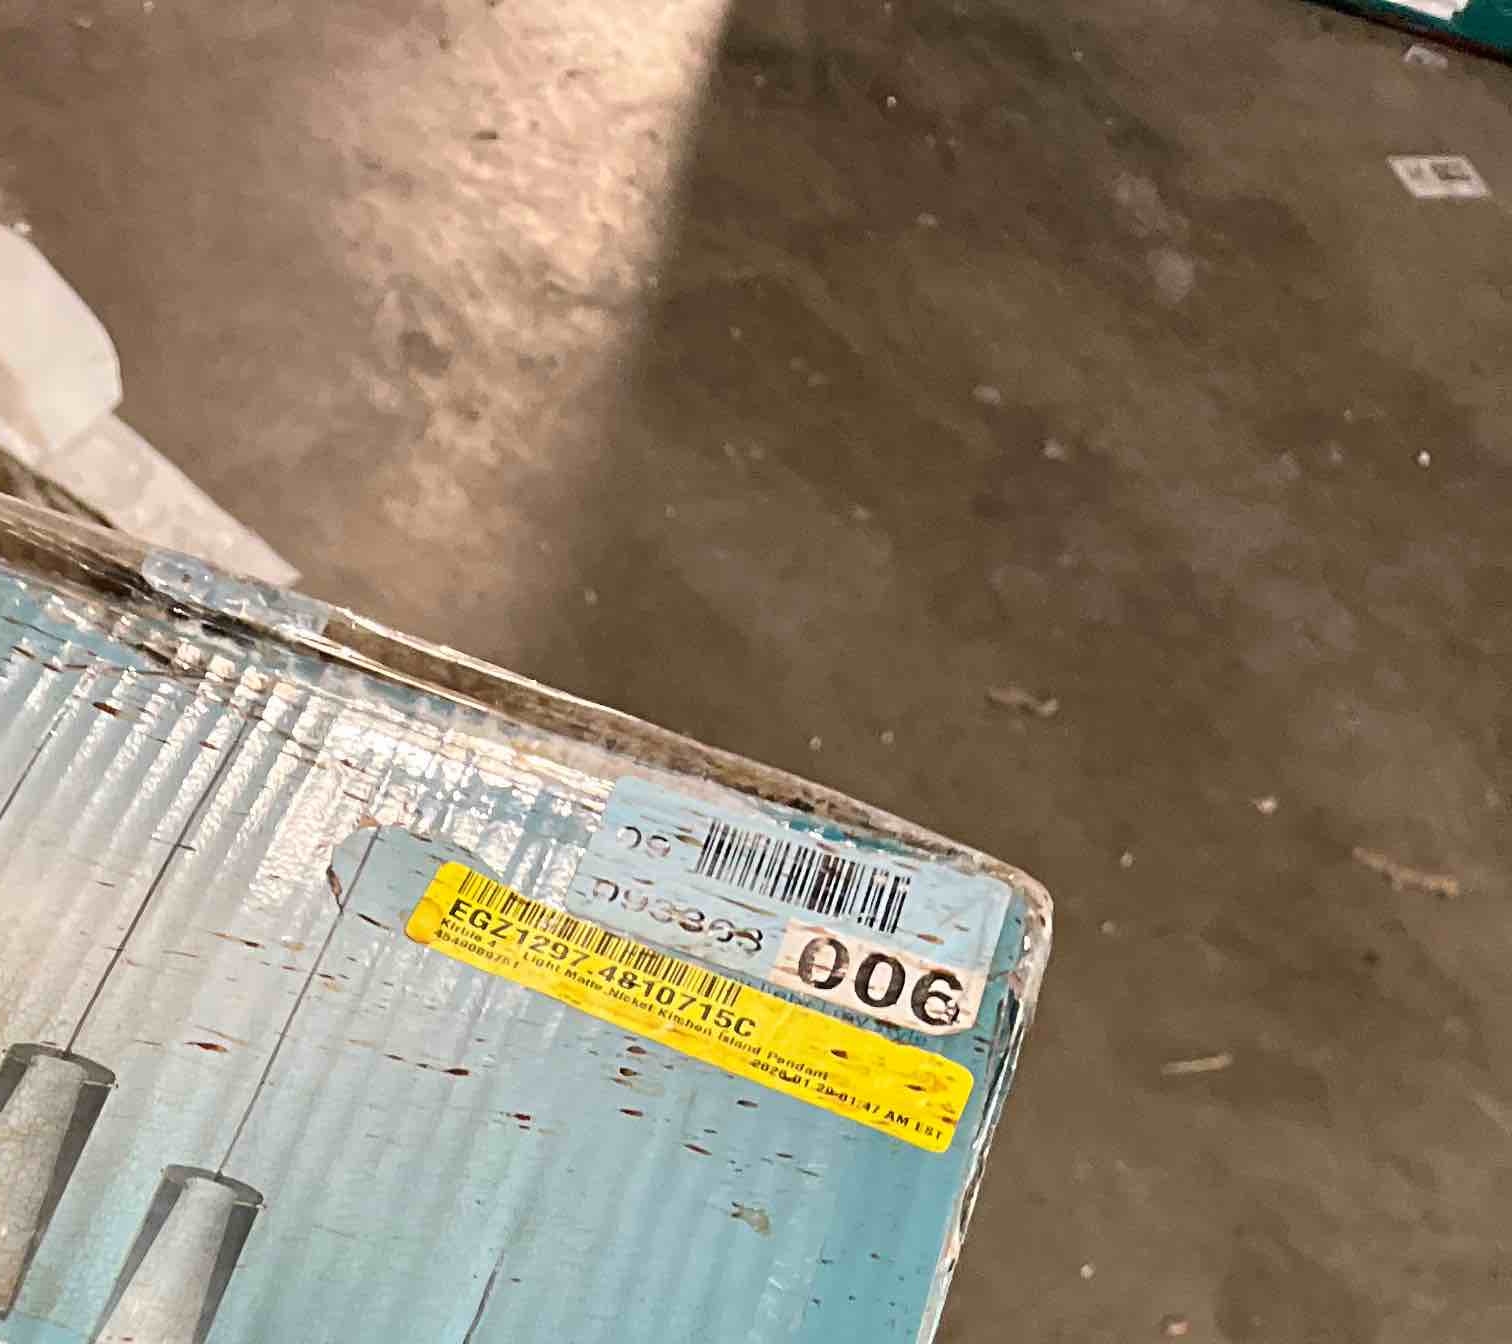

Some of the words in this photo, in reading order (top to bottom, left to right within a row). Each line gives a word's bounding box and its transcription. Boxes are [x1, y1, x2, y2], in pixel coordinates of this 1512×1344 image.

[523, 951, 560, 972] Light
[797, 936, 963, 1027] 006
[884, 1109, 910, 1127] AM
